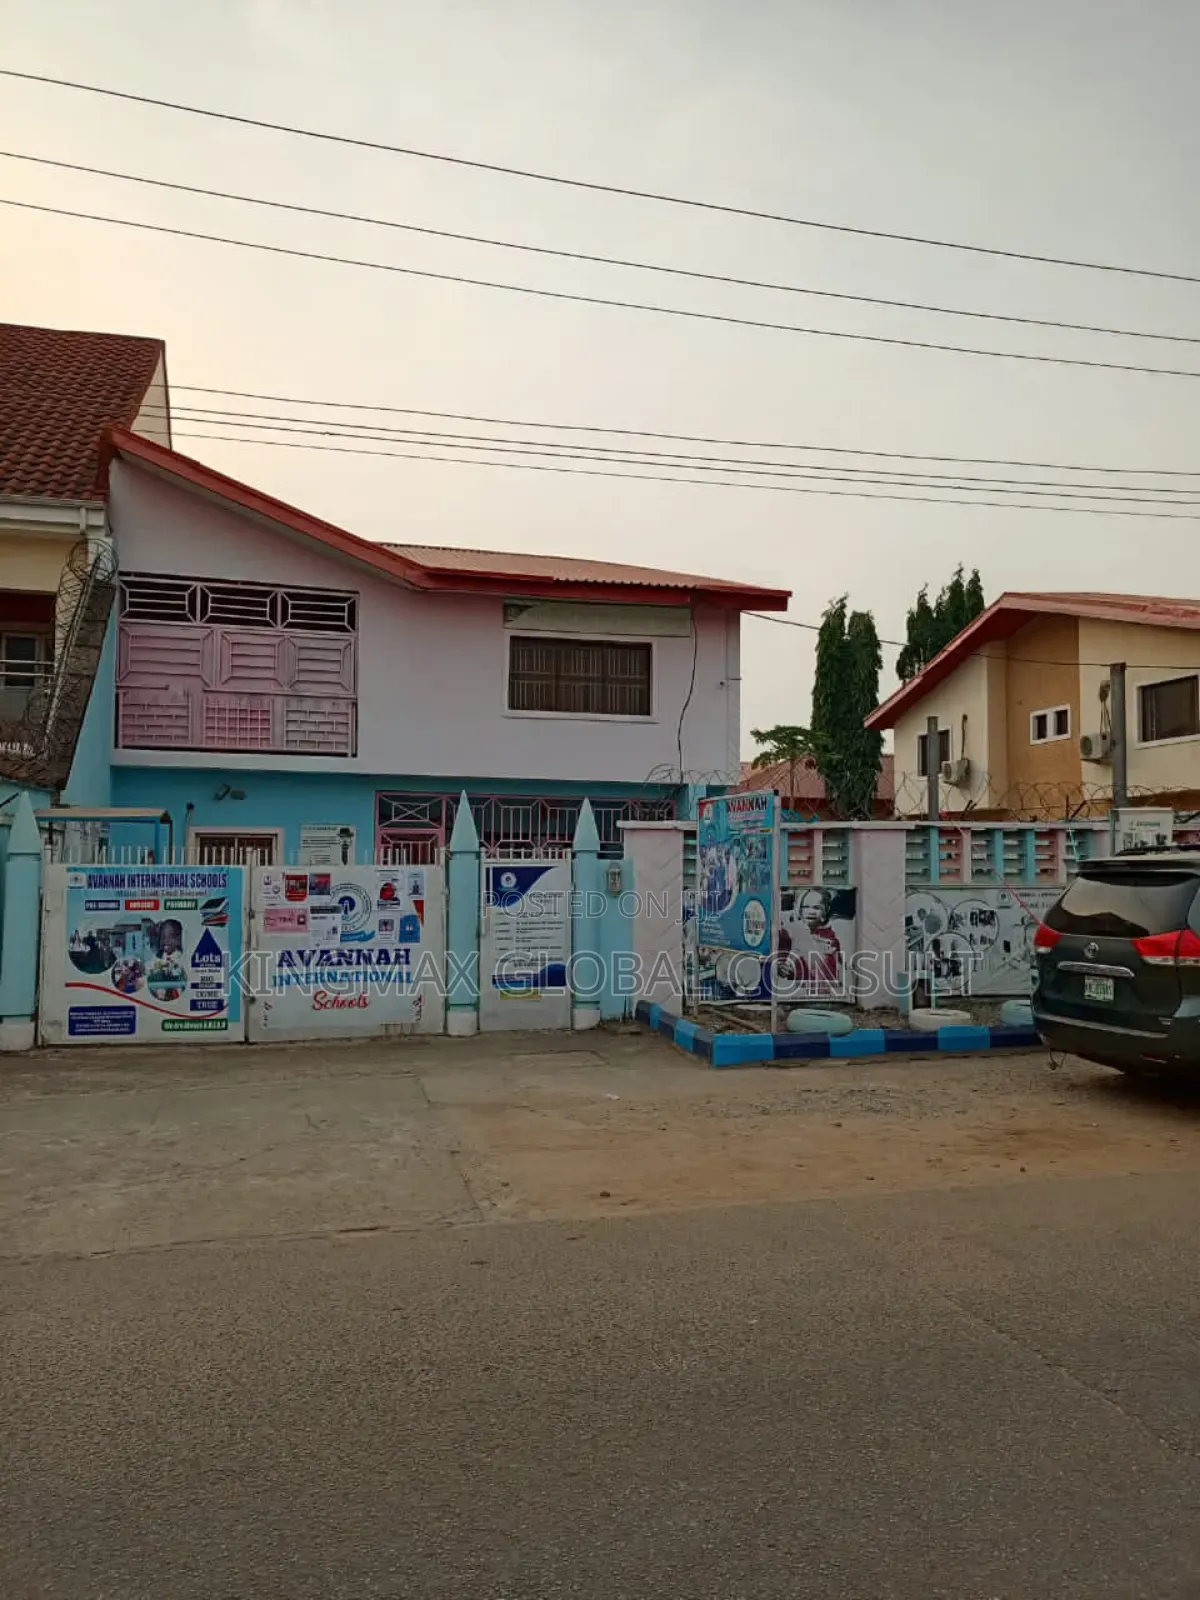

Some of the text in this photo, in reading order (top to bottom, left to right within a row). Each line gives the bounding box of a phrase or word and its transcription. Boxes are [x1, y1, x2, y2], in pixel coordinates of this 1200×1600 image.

[728, 797, 767, 813] AVANNAH
[87, 872, 227, 889] AVANNAH INTERNATIONAL SCHOOLS
[166, 901, 195, 909] PRIMARY
[195, 953, 221, 963] Lots
[278, 949, 411, 967] AVANNAH
[272, 971, 414, 987] INTERNATIONAL
[312, 990, 369, 1011] Schools
